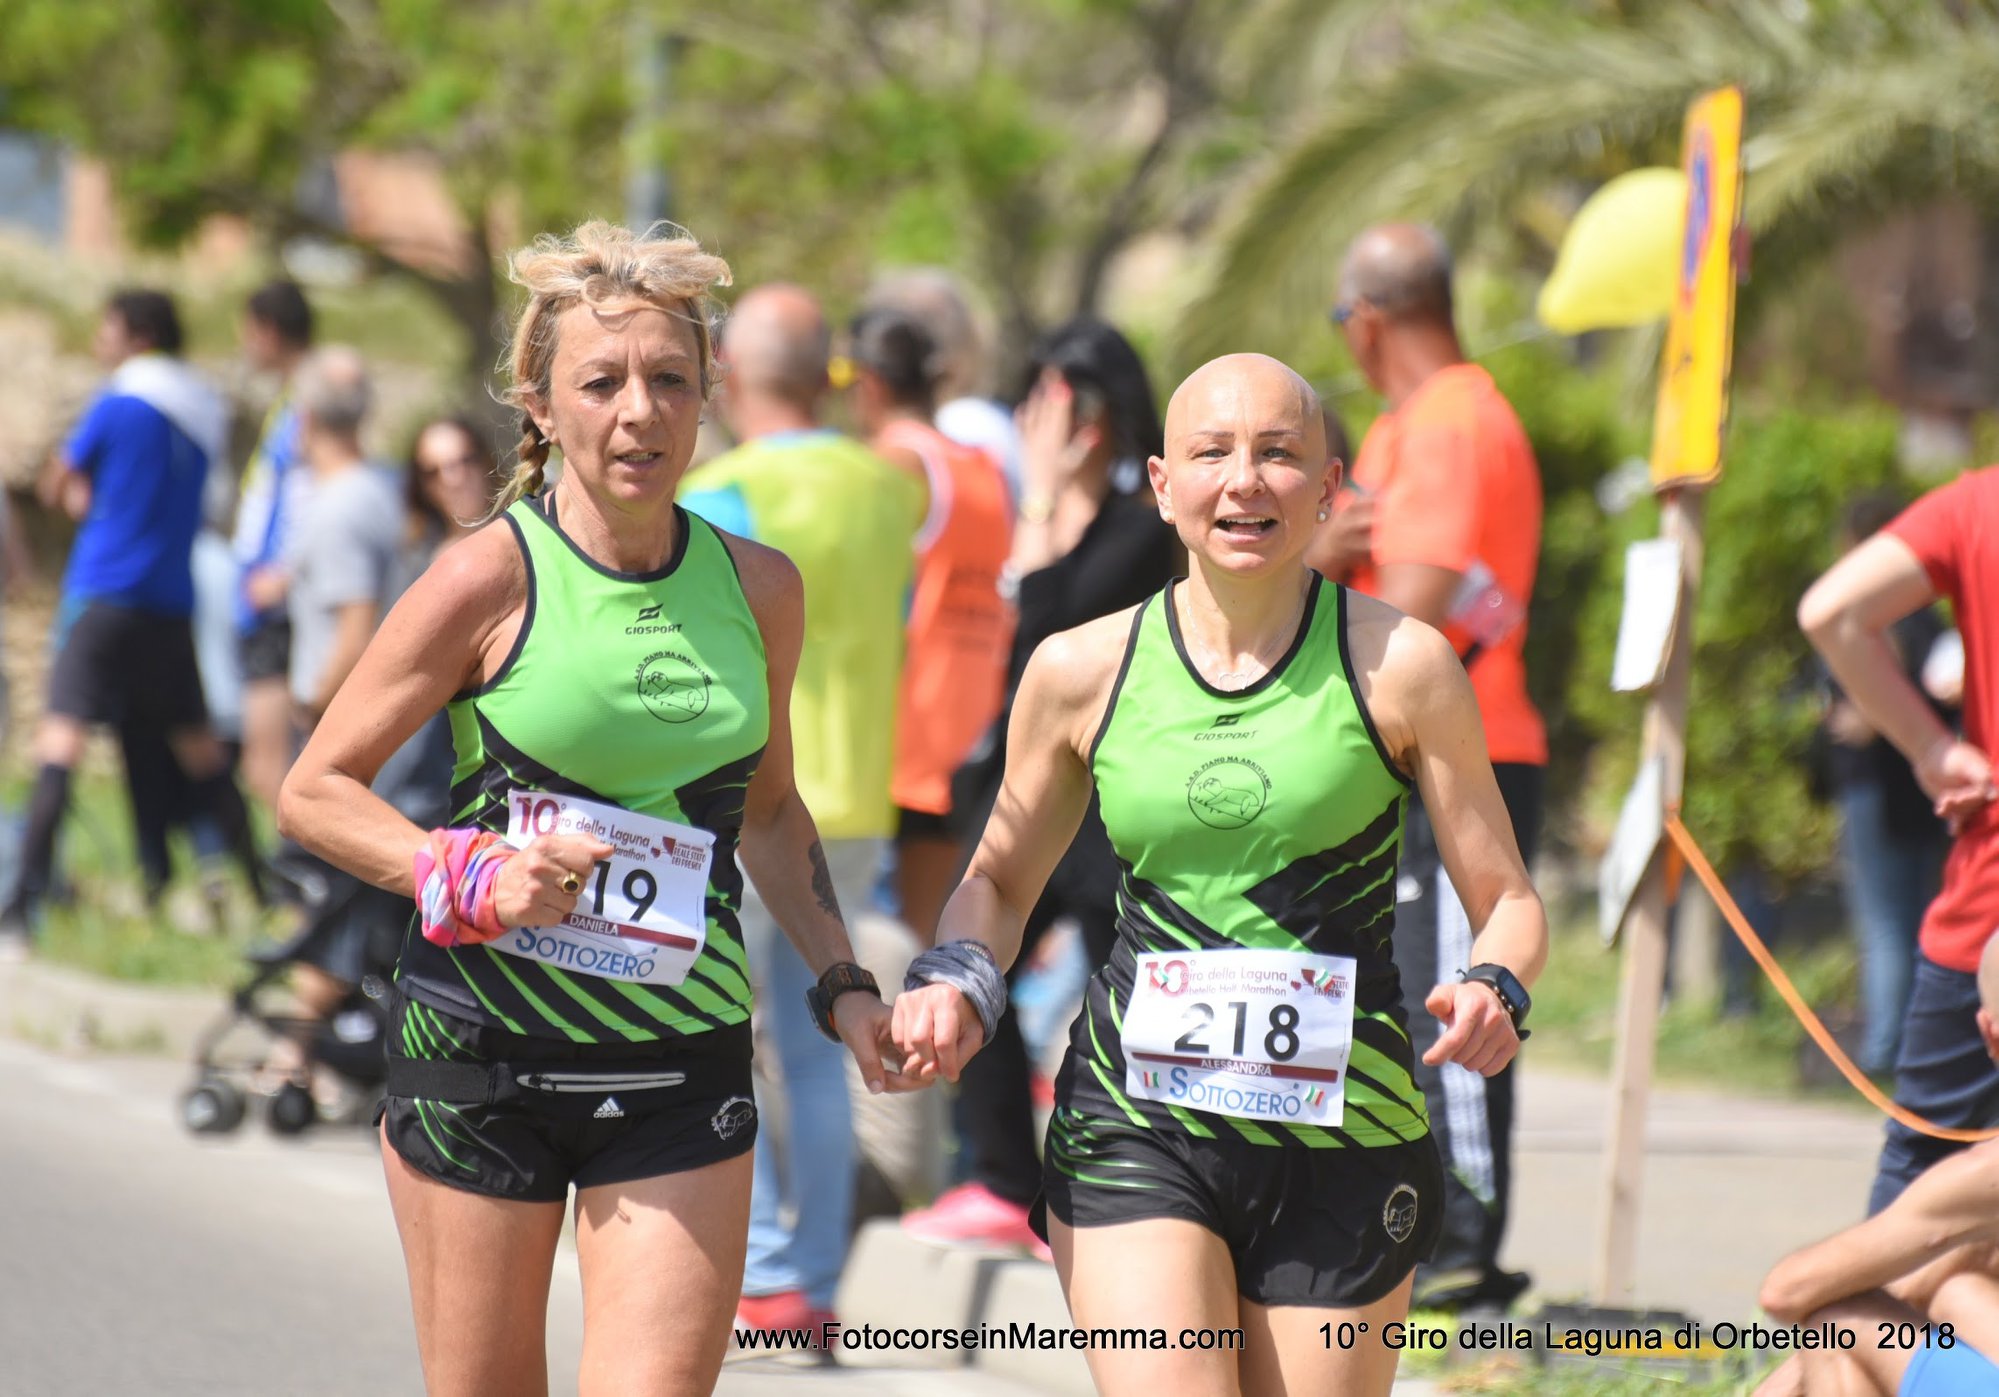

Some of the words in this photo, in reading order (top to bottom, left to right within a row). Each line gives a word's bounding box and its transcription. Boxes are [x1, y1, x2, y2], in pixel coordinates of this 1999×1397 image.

[624, 623, 682, 635] GIOSPORT
[1193, 729, 1258, 742] GIOSPORT
[576, 817, 606, 836] della
[609, 823, 650, 848] Laguna
[593, 859, 658, 923] 19
[569, 914, 620, 937] DANIELA
[1208, 967, 1236, 981] della
[1240, 967, 1288, 983] Laguna
[1219, 983, 1238, 993] Half
[1241, 983, 1287, 998] Marathon
[1173, 1001, 1301, 1063] 218
[1200, 1059, 1273, 1077] ALESSANDRA
[593, 1109, 625, 1119] adidas
